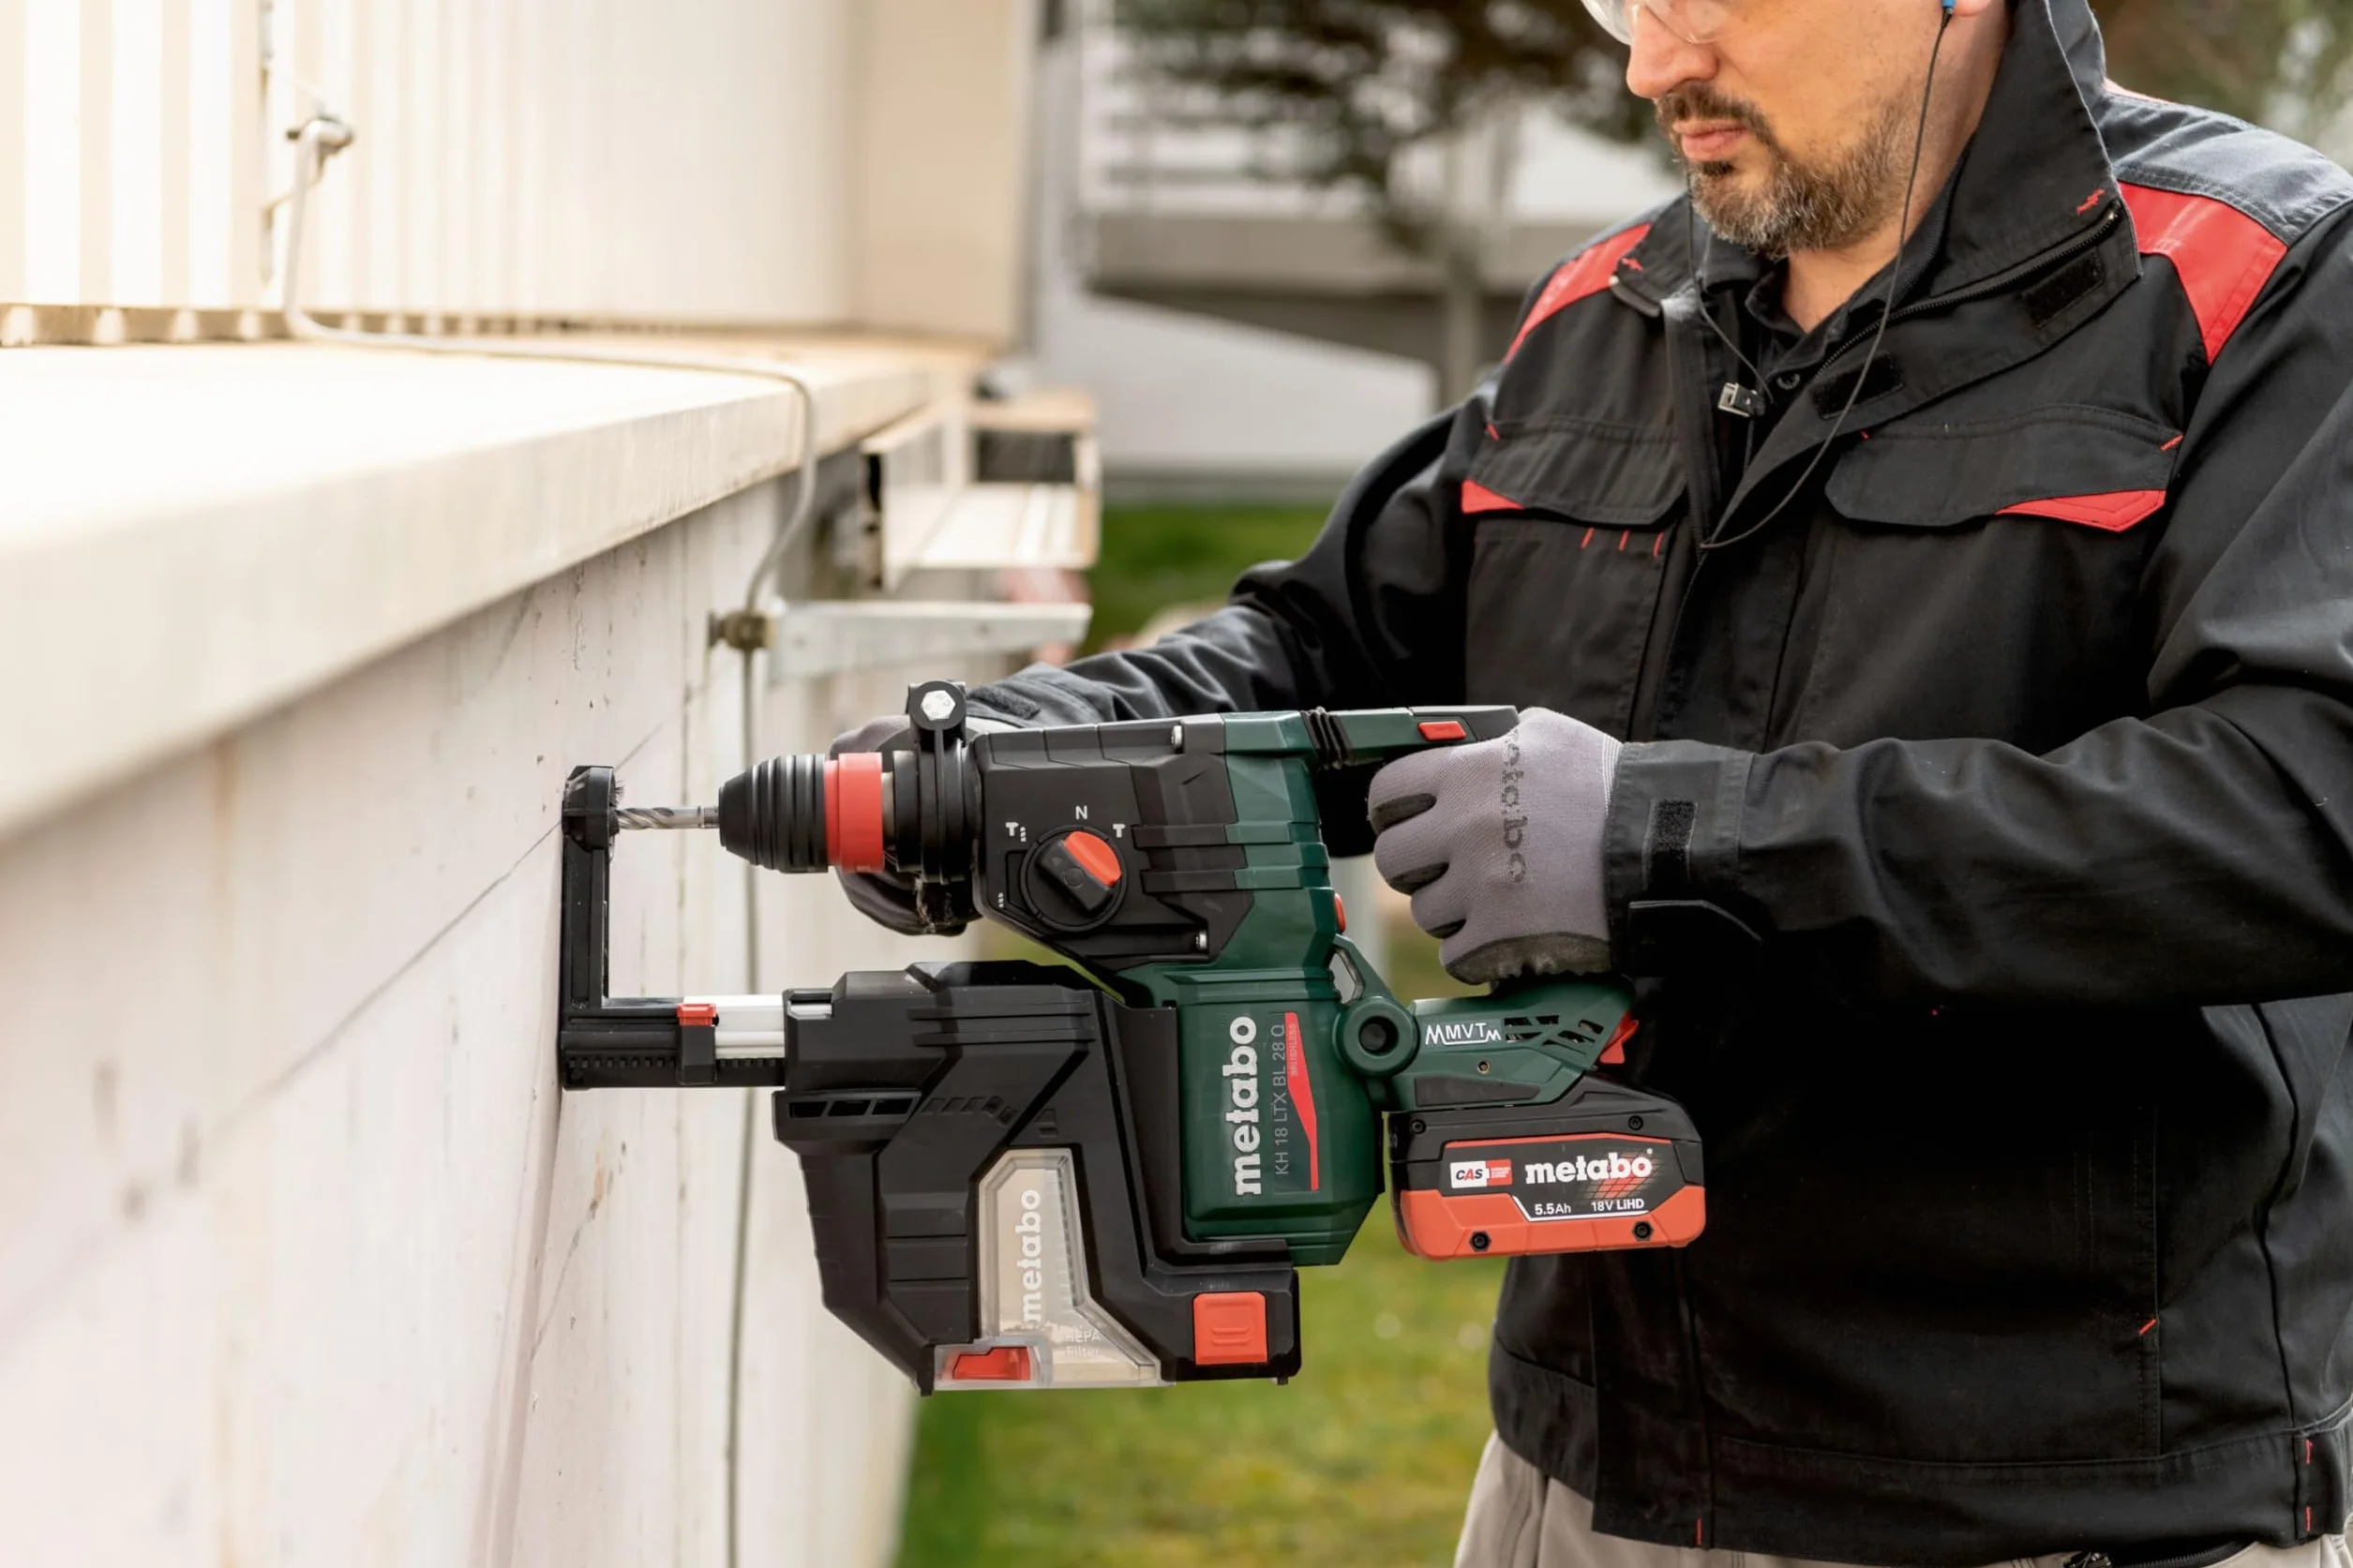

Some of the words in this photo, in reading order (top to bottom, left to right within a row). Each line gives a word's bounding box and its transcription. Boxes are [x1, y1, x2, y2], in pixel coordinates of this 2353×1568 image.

[1075, 805, 1088, 820] N
[1270, 1023, 1285, 1038] Q
[1271, 1041, 1286, 1062] 28
[1272, 1064, 1288, 1087] BL
[1222, 1016, 1262, 1196] metabo
[1272, 1092, 1289, 1122] LTX
[1274, 1127, 1289, 1145] 18
[1274, 1151, 1290, 1175] KH
[1525, 1152, 1653, 1184] metabo
[1455, 1168, 1483, 1181] CAS
[1534, 1202, 1571, 1216] 5.5Ah
[1591, 1201, 1613, 1213] 18V
[1615, 1198, 1645, 1211] LiHD
[1015, 1188, 1042, 1323] metabo
